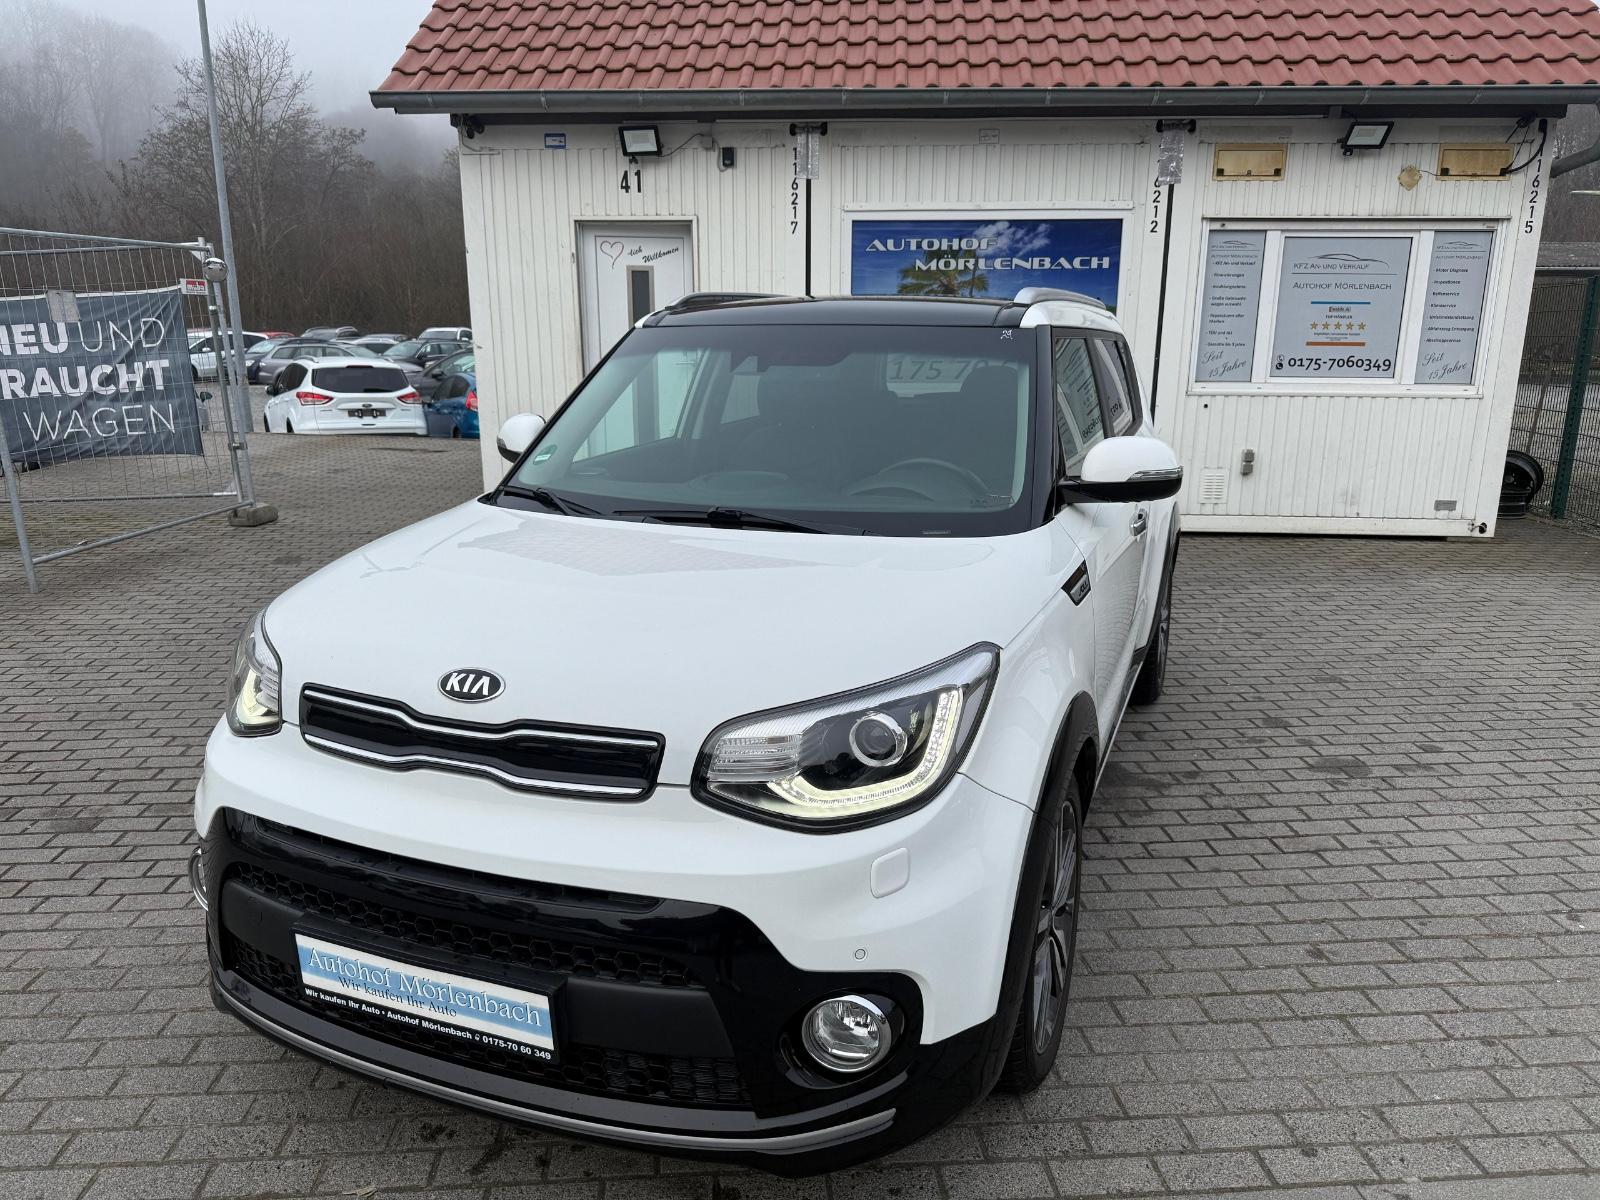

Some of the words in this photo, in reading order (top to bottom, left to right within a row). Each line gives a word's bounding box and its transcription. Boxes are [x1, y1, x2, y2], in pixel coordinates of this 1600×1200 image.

[620, 170, 642, 194] 41
[865, 237, 998, 252] AUTOHOF
[915, 254, 1110, 271] MÖRLENBACH
[77, 317, 165, 353] UND
[0, 359, 169, 400] RAUCHT
[1288, 355, 1392, 372] 0175-7060349
[23, 403, 176, 442] WAGEN
[445, 672, 491, 696] KIA
[307, 946, 392, 988] Autohof
[398, 970, 543, 1028] Mörlenbach
[337, 976, 361, 992] Wir
[363, 982, 404, 1004] kaufen
[406, 993, 425, 1010] Ihr
[428, 999, 458, 1018] Auto
[304, 987, 319, 997] Wir
[319, 990, 347, 1007] kaufen
[348, 998, 360, 1009] Ihr
[361, 1001, 381, 1015] Auto
[386, 1010, 420, 1027] Autohof
[421, 1019, 473, 1040] Mörlenbach
[482, 1034, 519, 1052] 0175-70
[520, 1044, 532, 1056] 60
[534, 1049, 552, 1061] 349
